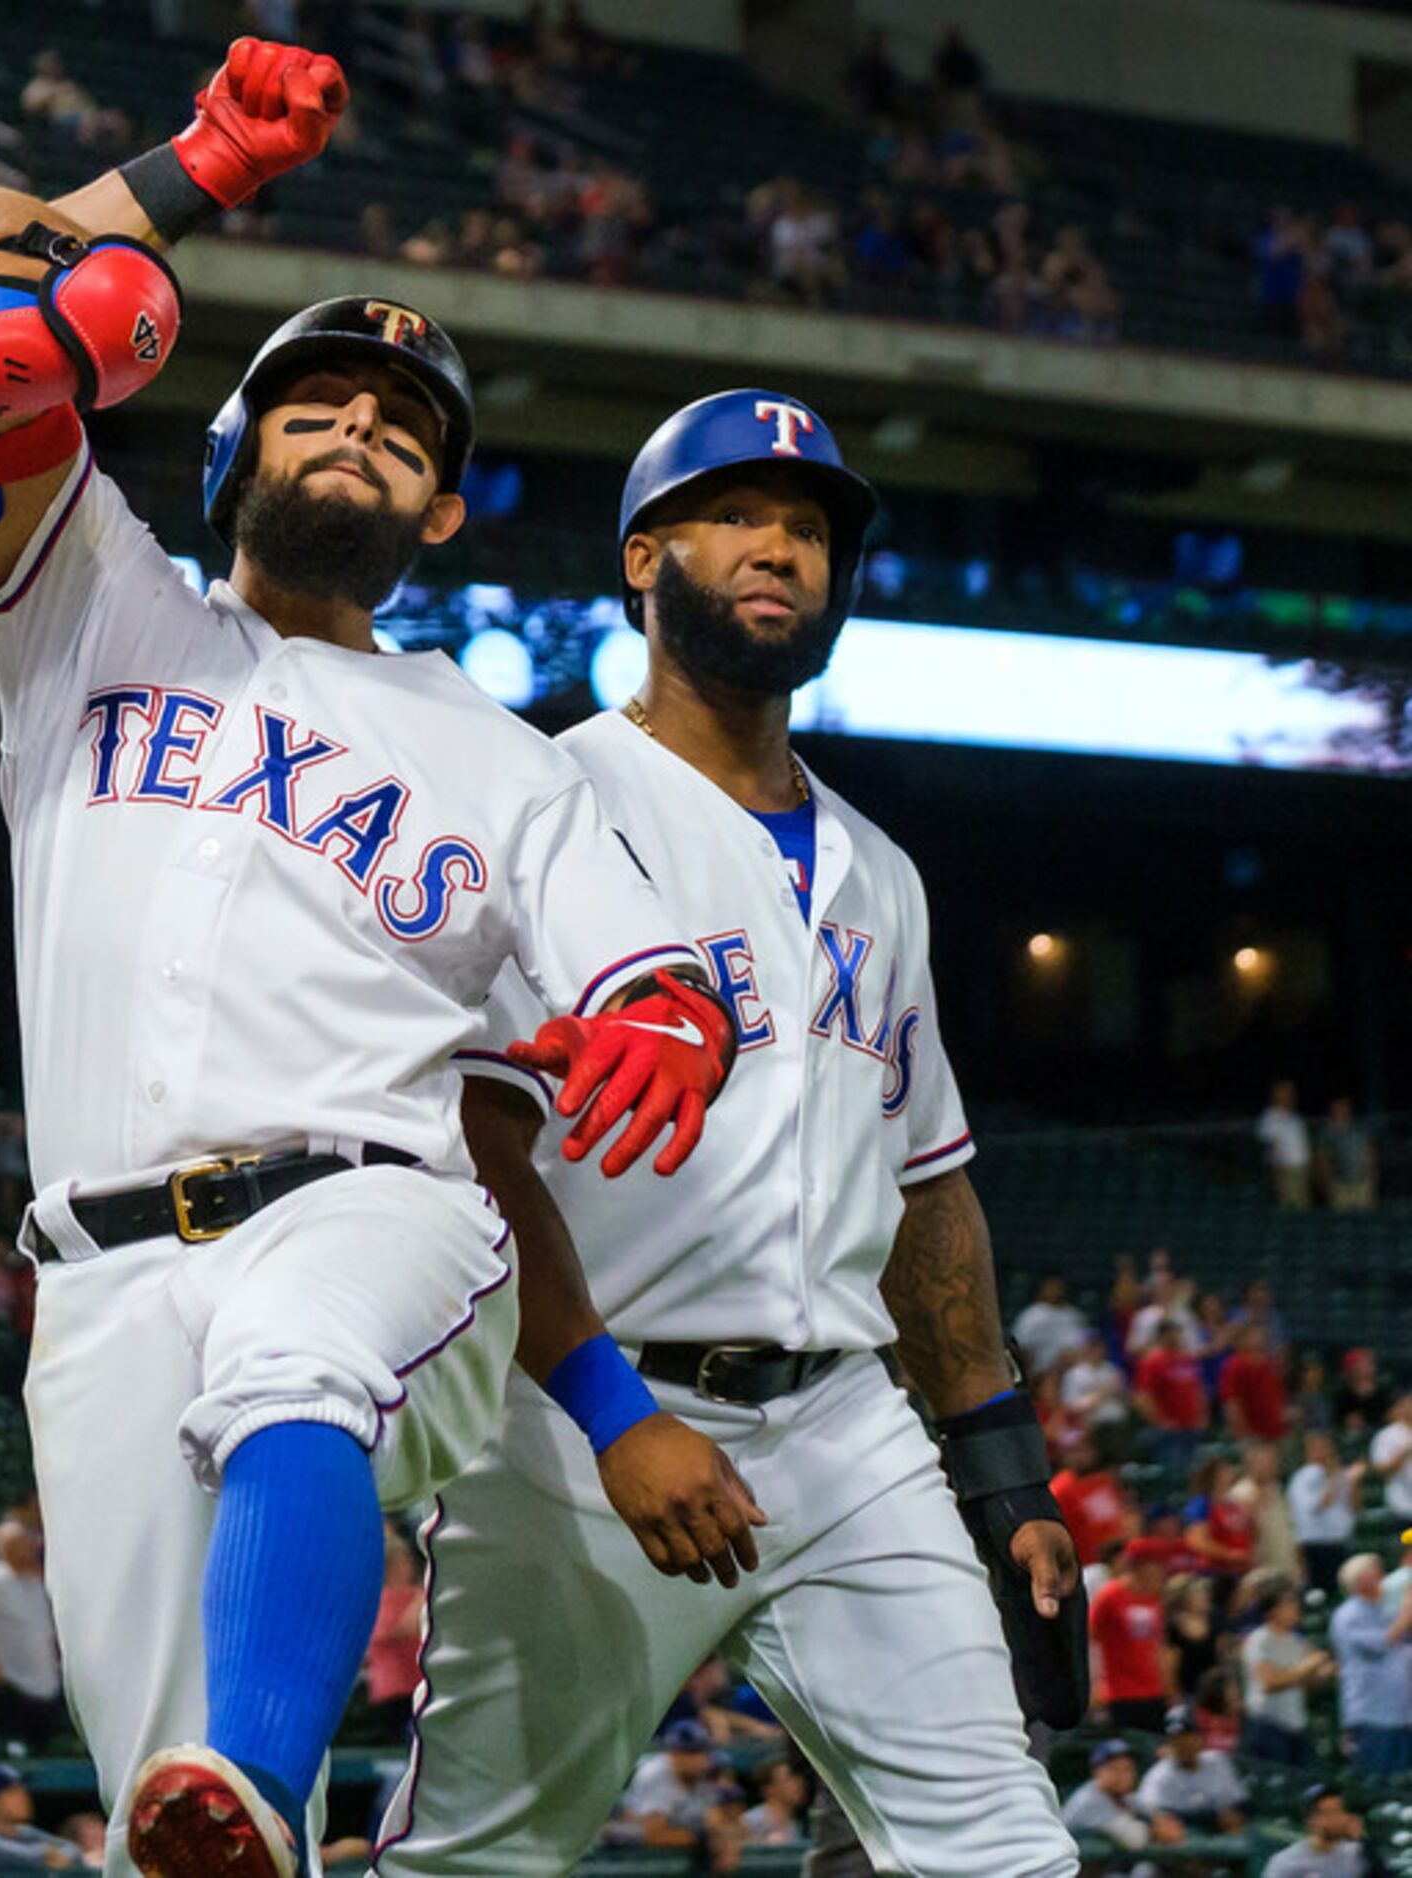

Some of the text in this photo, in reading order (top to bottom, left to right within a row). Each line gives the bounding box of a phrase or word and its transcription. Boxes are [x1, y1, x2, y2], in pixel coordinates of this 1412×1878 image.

[364, 300, 426, 347] T
[754, 400, 814, 457] T
[78, 683, 488, 943] TEXAS
